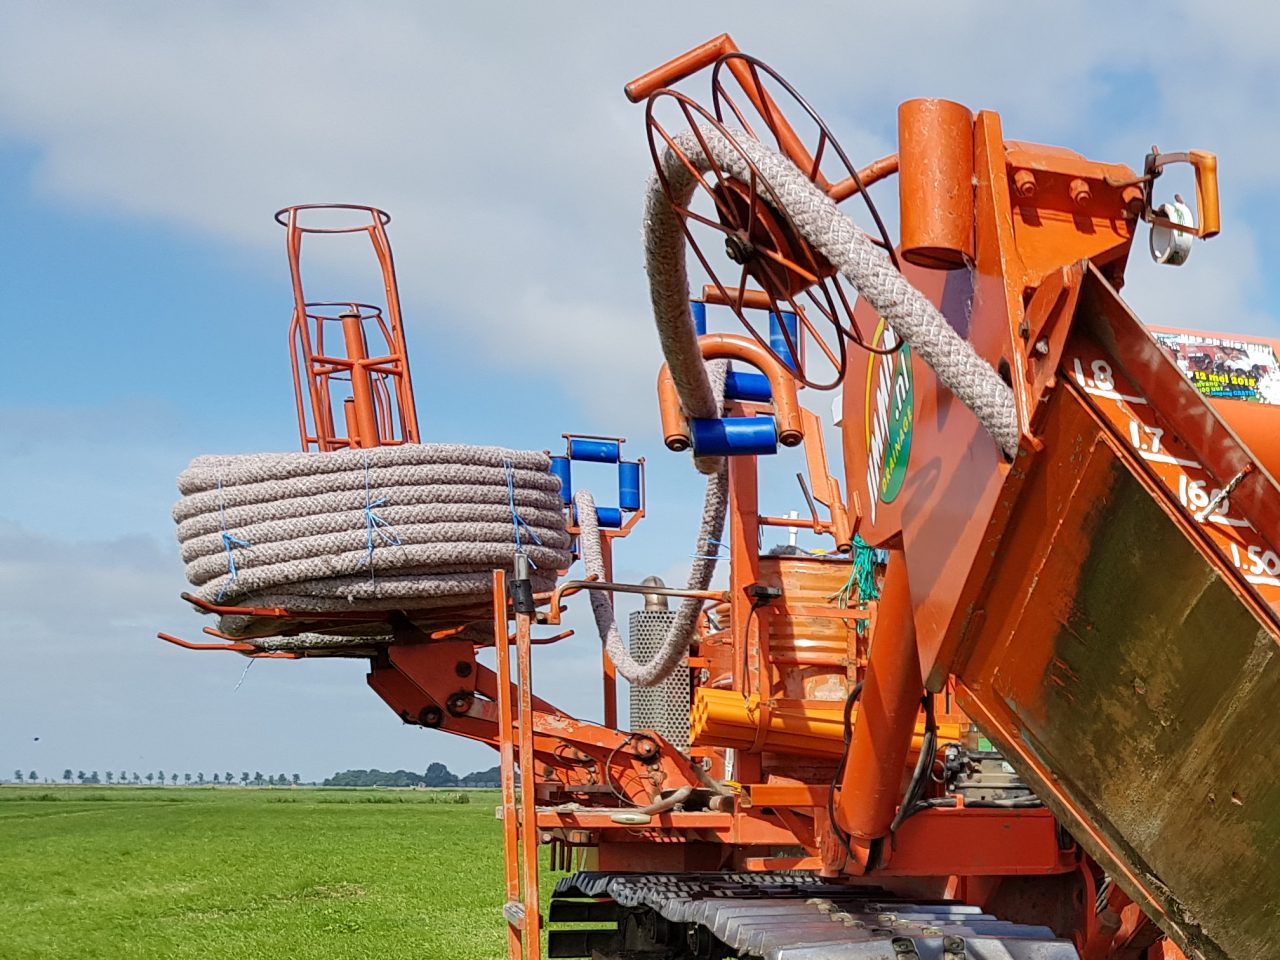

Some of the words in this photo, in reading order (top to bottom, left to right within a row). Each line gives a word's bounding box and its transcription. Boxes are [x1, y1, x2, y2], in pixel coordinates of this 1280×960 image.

[1073, 357, 1115, 391] 1.8
[1194, 371, 1207, 381] 12
[882, 405, 913, 494] DRAINAGE
[1129, 420, 1164, 453] 1.7
